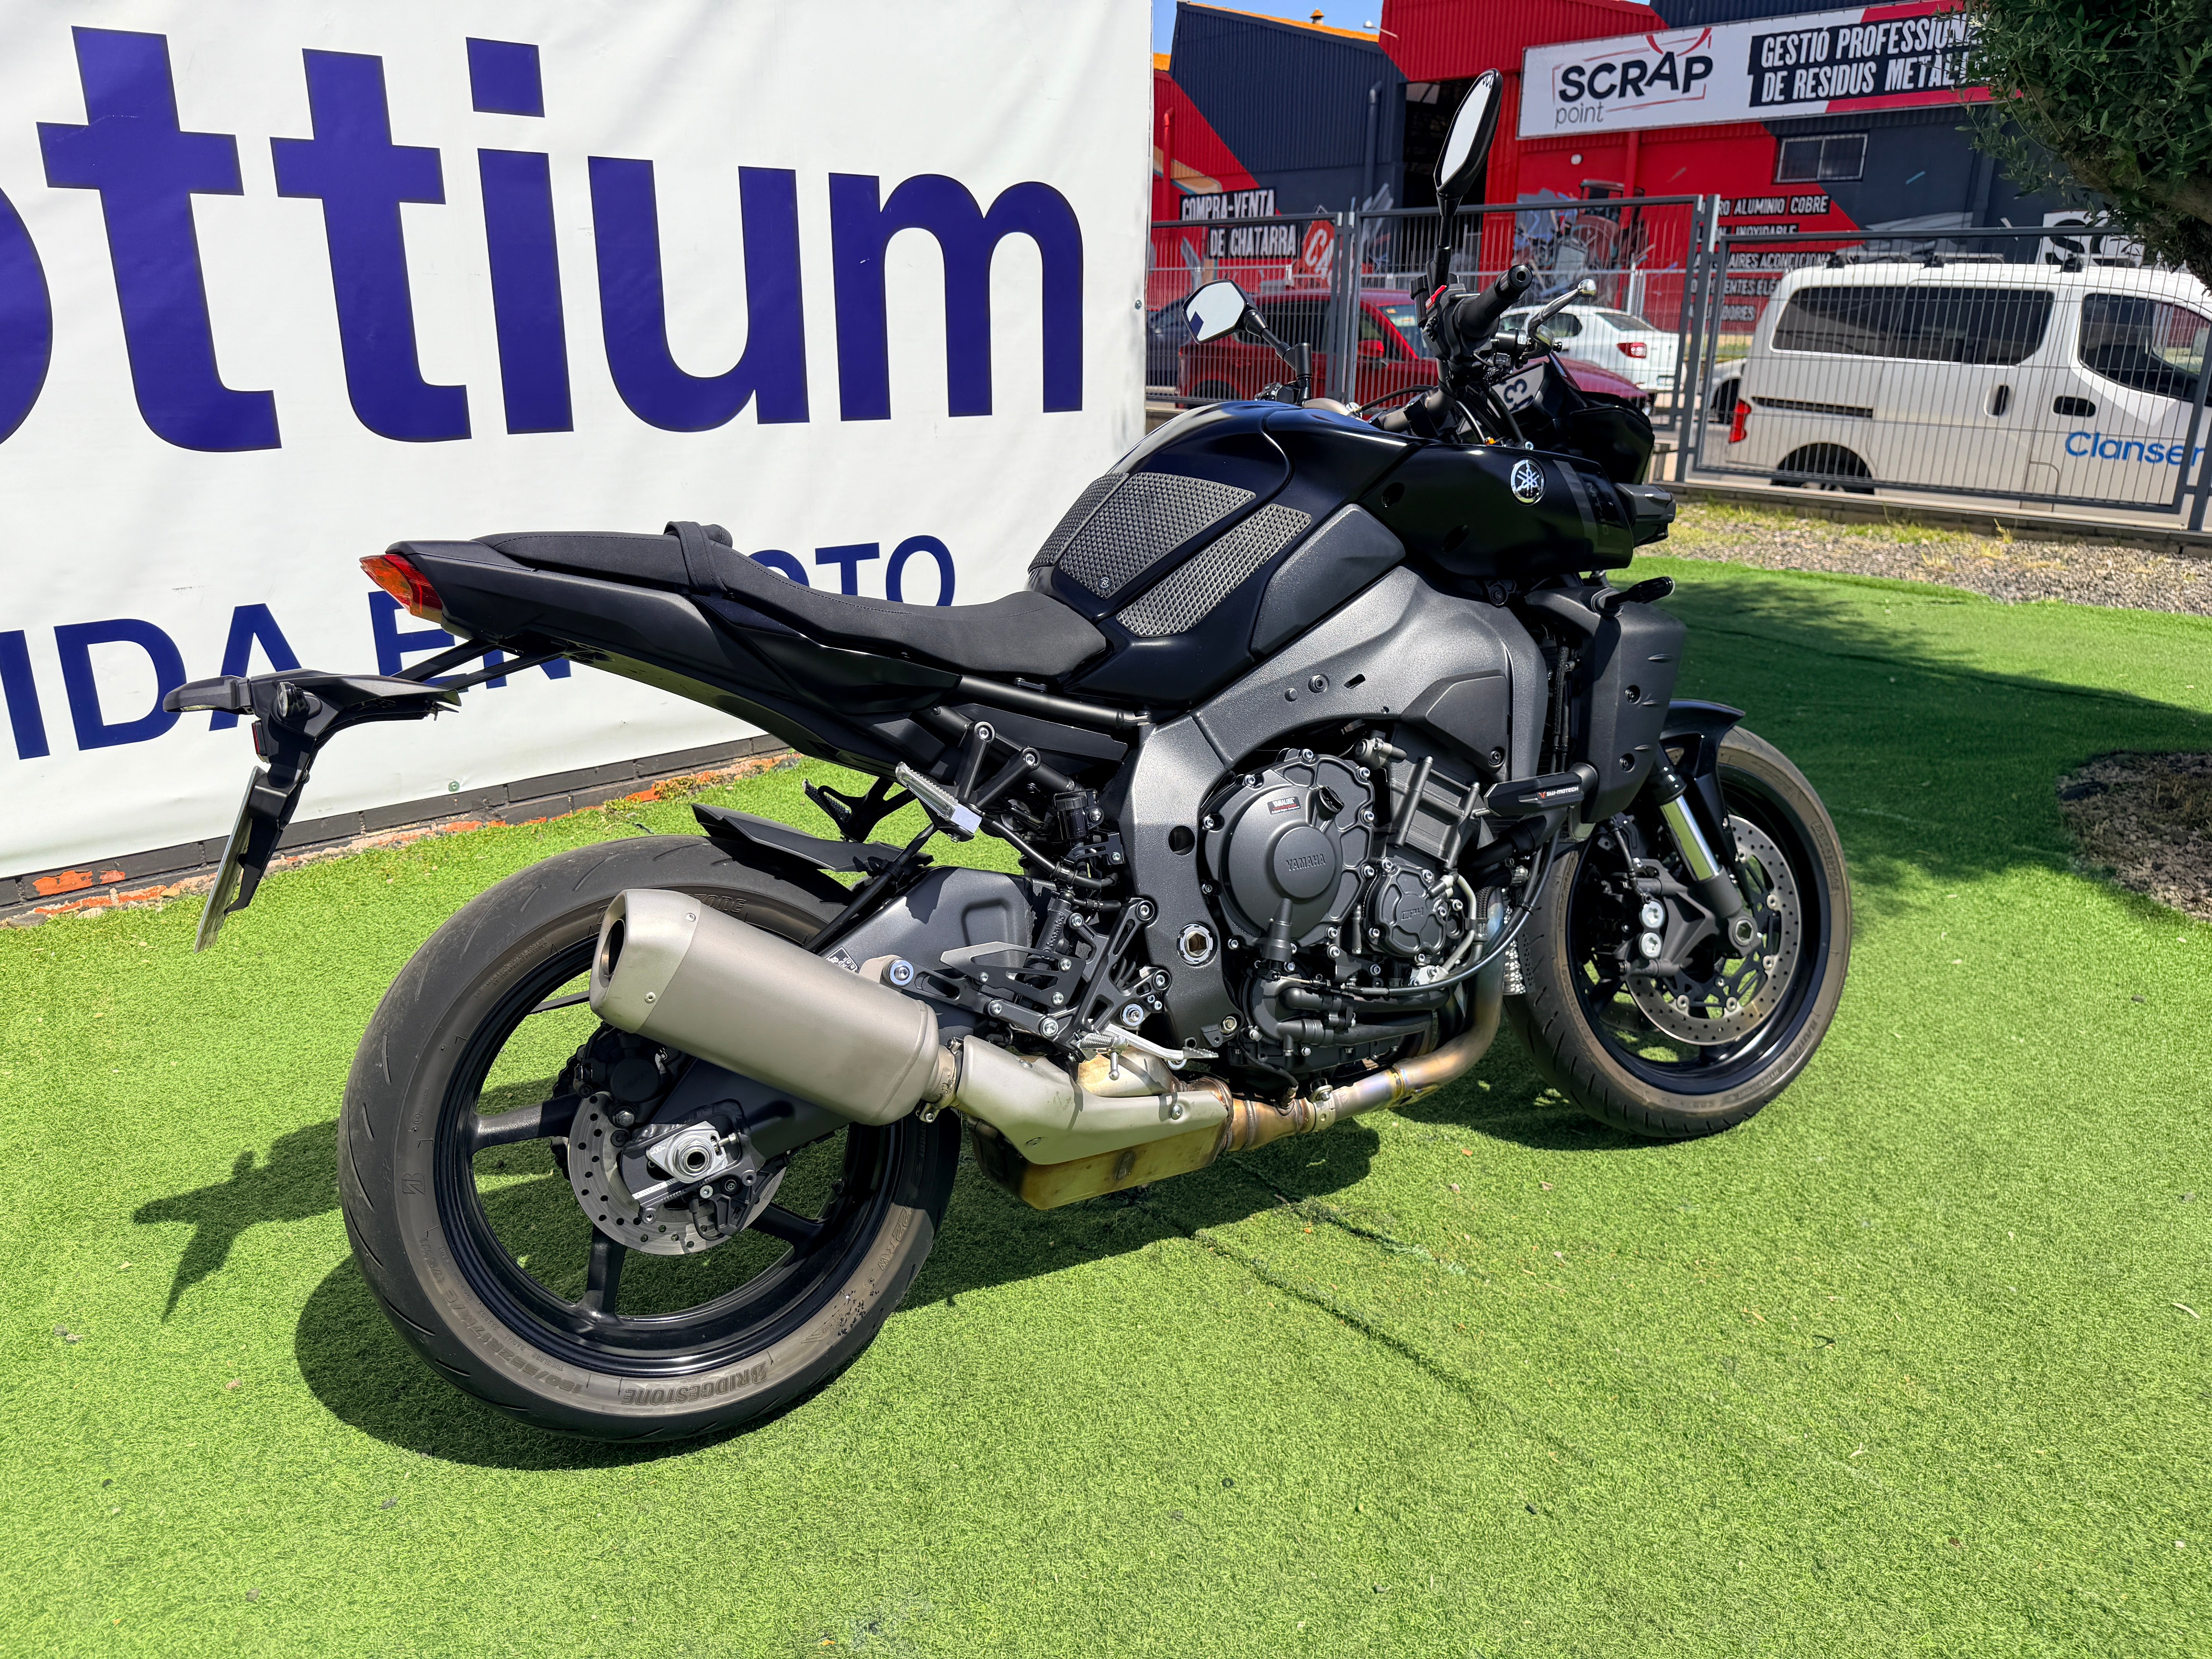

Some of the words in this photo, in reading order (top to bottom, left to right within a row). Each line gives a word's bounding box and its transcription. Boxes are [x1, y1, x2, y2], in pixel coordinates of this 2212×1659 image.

[1761, 27, 1830, 69] GESTIÓ
[1559, 51, 1713, 103] SCRAP
[1761, 70, 1788, 103] DE
[1792, 61, 1877, 101] RESIDUS
[1554, 101, 1604, 129] point
[1182, 189, 1275, 222] COMPRA-VENTA
[1734, 198, 1786, 216] ALUMINIO
[1790, 195, 1830, 213] COBRE
[0, 26, 1084, 453] ttium
[1210, 228, 1226, 257] DE
[1230, 224, 1297, 257] CHATARRA
[1727, 253, 1760, 269] AIRES
[2065, 431, 2205, 466] Clanser
[1546, 786, 1579, 797] SW-MOTECH
[1286, 853, 1326, 871] YAMAHA
[1401, 907, 1424, 921] CP4
[621, 1360, 770, 1406] BRIDGESTONE
